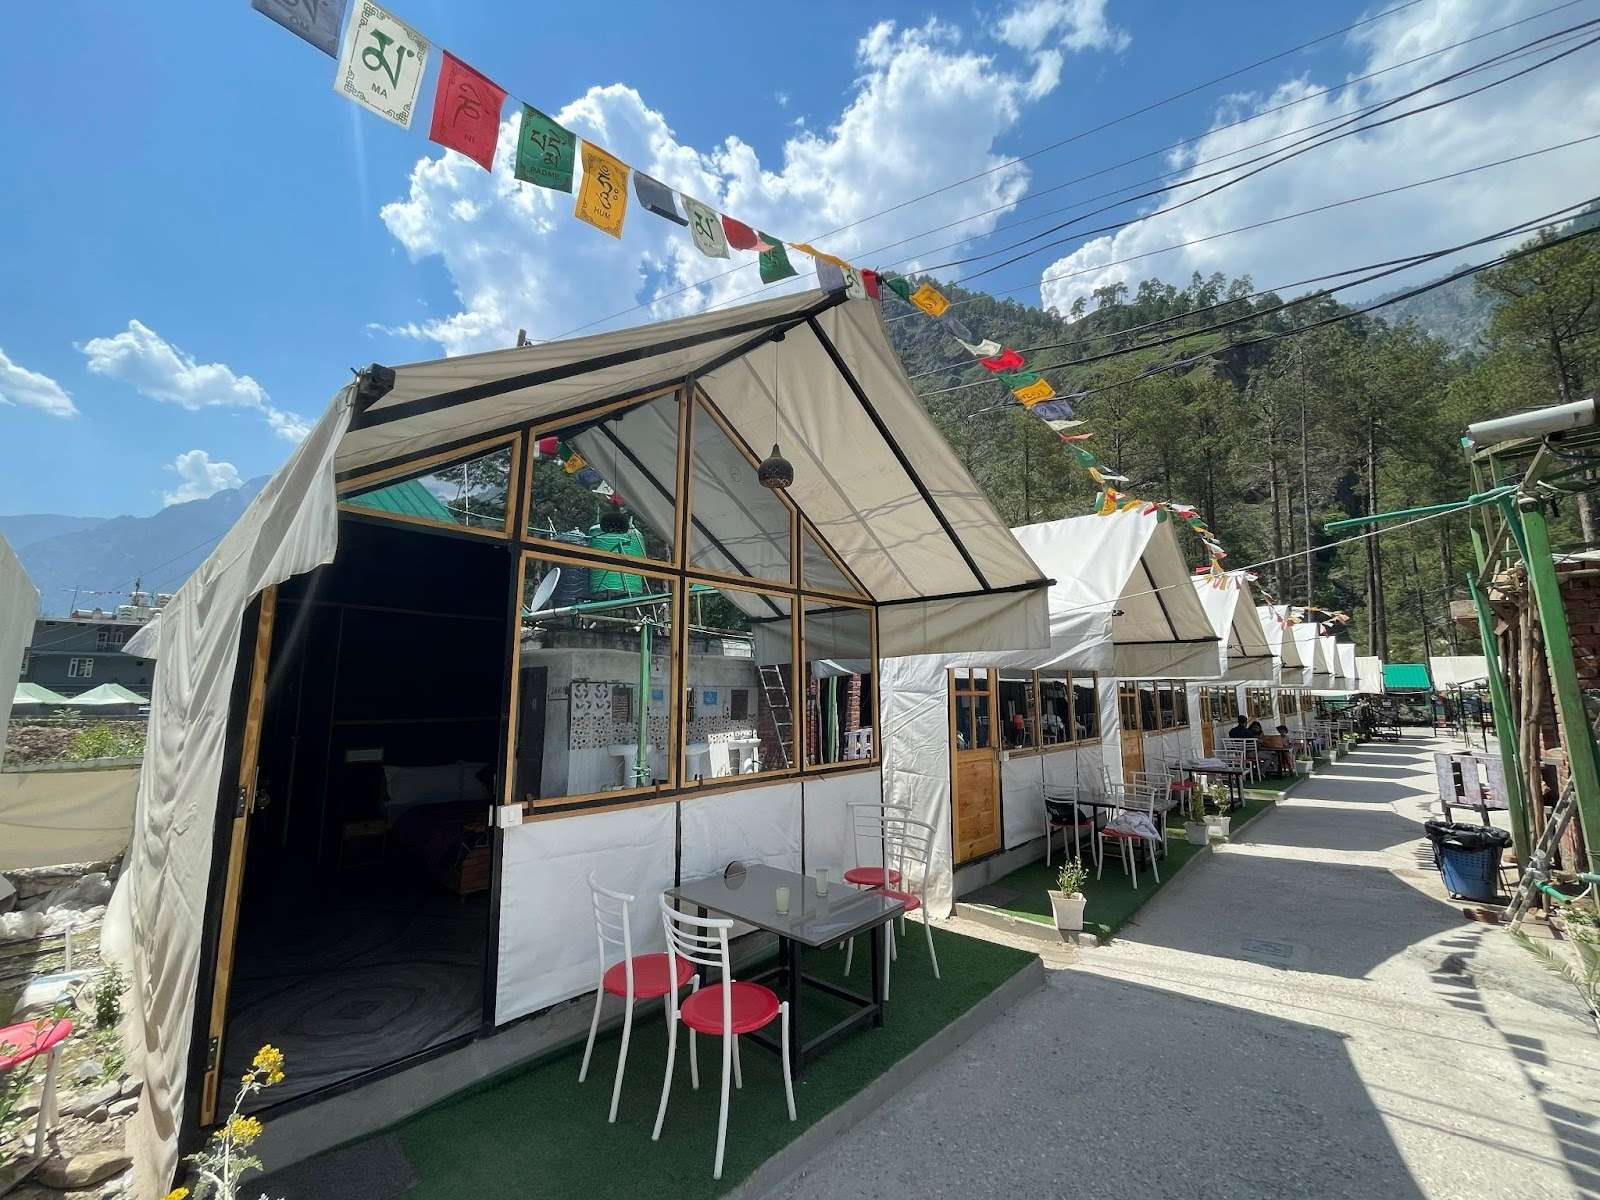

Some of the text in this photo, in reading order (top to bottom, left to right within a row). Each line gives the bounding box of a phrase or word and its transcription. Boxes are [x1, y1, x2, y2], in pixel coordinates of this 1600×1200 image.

[371, 82, 388, 99] MA
[464, 133, 476, 144] NI
[530, 166, 560, 179] PADME
[593, 206, 611, 220] HUM
